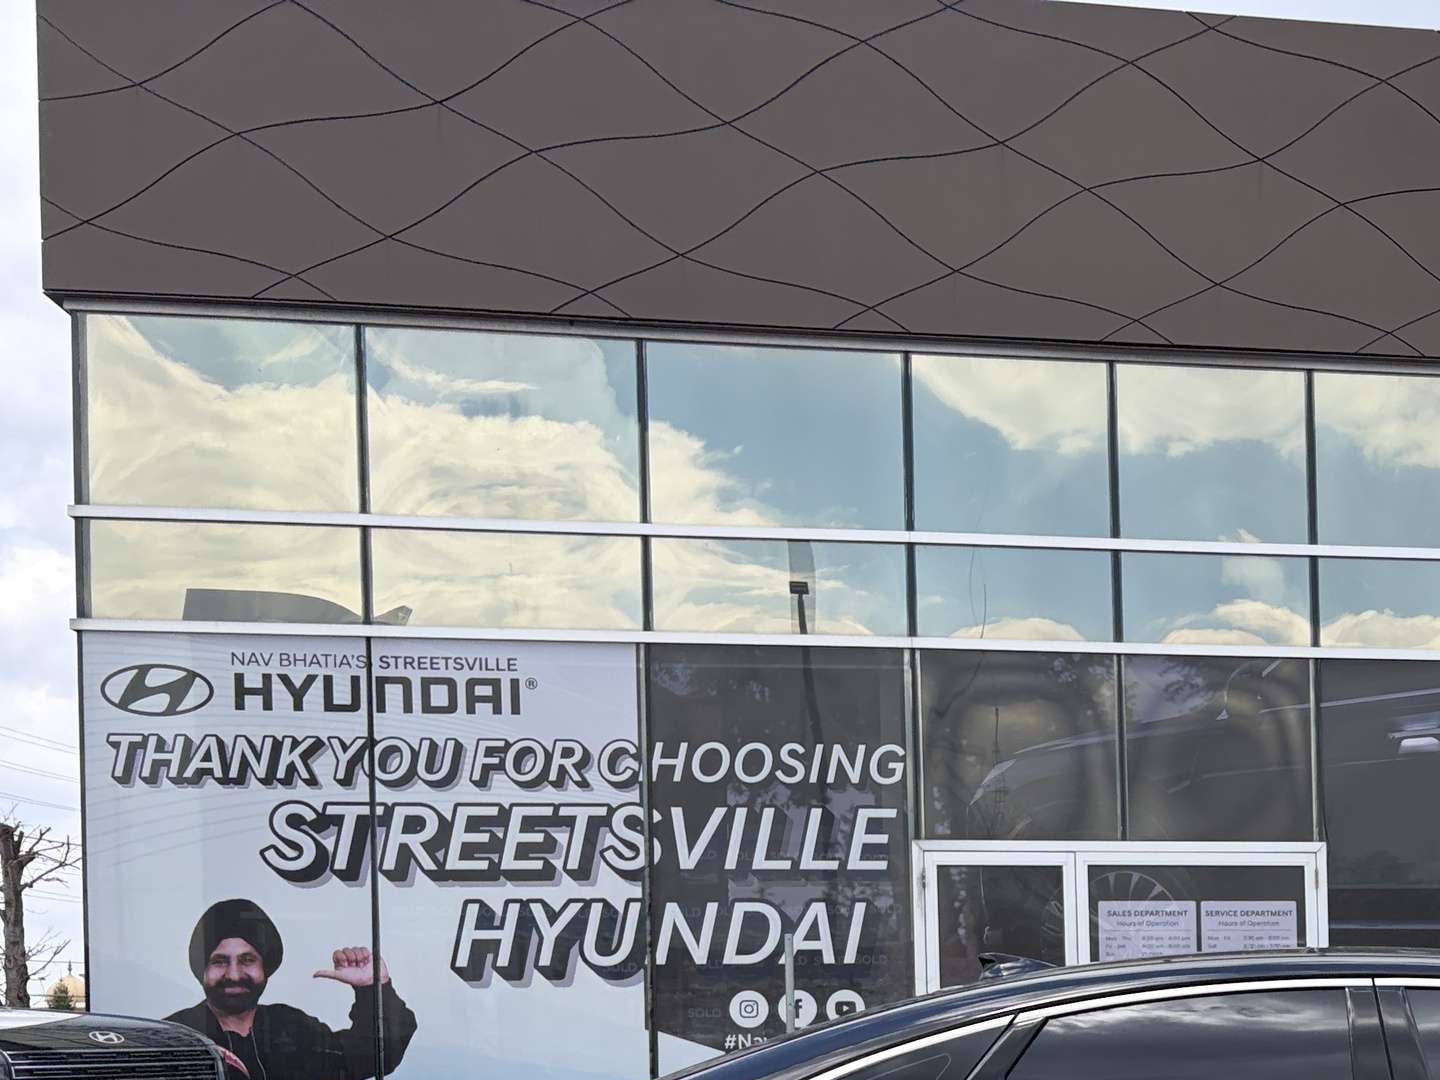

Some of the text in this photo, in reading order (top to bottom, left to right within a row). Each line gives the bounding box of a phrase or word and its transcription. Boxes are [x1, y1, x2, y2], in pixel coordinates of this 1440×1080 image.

[231, 652, 518, 672] NAV BHATIA'S STREETSVILLE
[107, 733, 906, 791] THANK YOU FOR CHOOSING
[259, 800, 898, 885] STREETSVILLE
[450, 898, 868, 979] HYUNDAI
